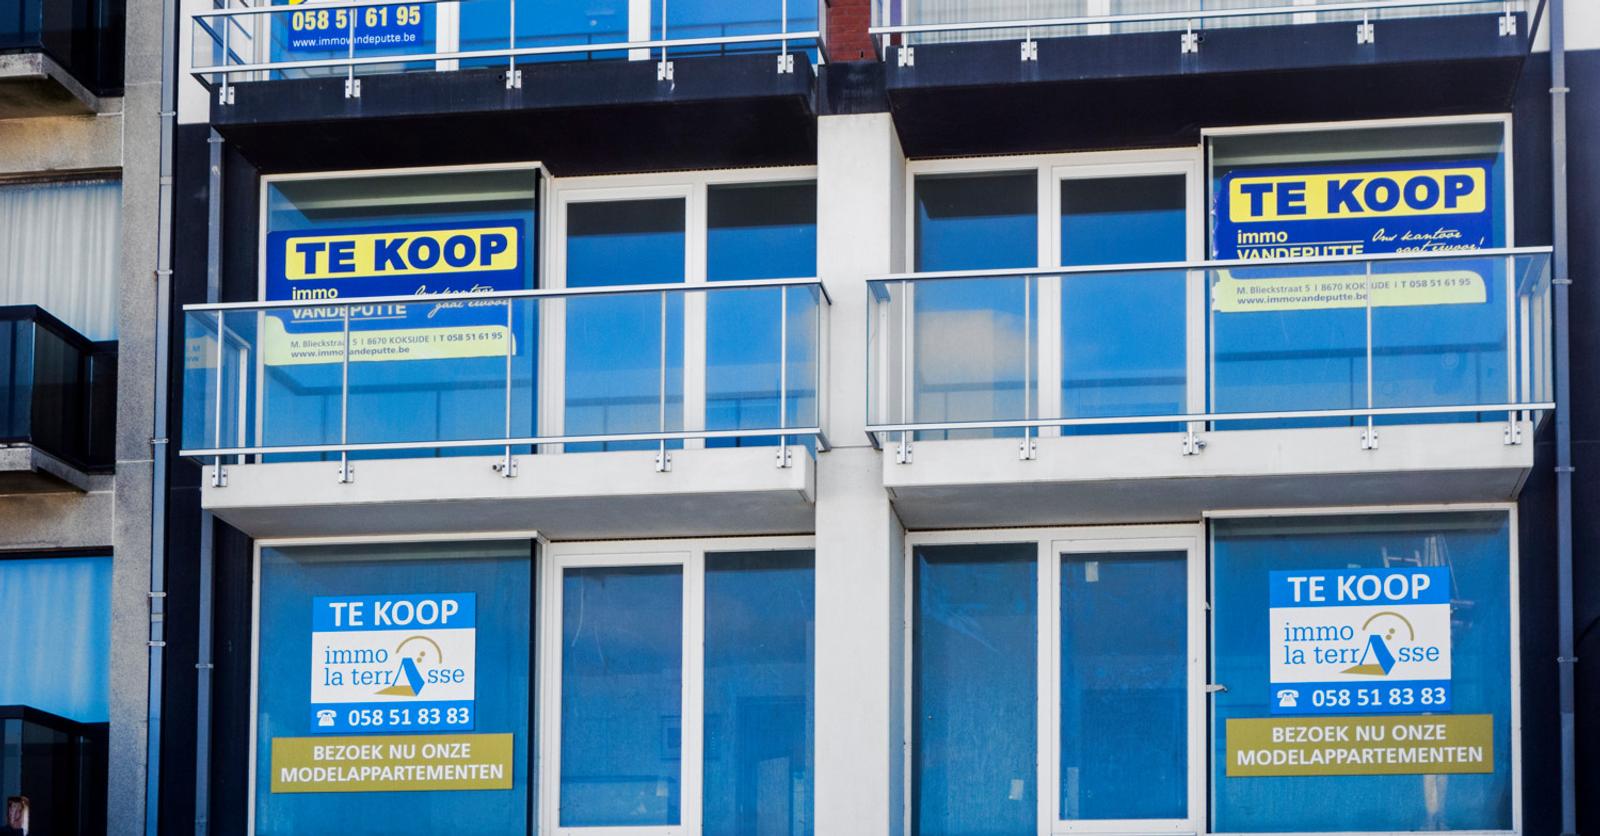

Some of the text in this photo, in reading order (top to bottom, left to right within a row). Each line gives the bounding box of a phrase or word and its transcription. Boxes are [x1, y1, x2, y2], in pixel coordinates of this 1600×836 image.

[292, 10, 329, 31] 058
[365, 7, 387, 27] 61
[396, 5, 421, 26] 95
[1240, 174, 1475, 217] TE KOOP
[1237, 230, 1288, 244] immo
[295, 233, 508, 275] TE KOOP
[292, 286, 338, 300] immo
[1321, 283, 1343, 292] 8670
[1409, 280, 1427, 288] 058
[1431, 279, 1442, 287] 51
[1444, 278, 1455, 286] 61
[1458, 277, 1471, 286] 95
[367, 336, 388, 345] 8670
[447, 333, 463, 342] 058
[466, 333, 476, 341] 51
[479, 332, 489, 341] 61
[491, 331, 503, 340] 95
[290, 346, 410, 358] www.immoandeputte.be
[1287, 573, 1431, 603] TE KOOP
[328, 599, 459, 627] TE KOOP
[1284, 621, 1354, 642] immo
[324, 645, 388, 665] immo
[1284, 645, 1306, 665] la
[324, 667, 344, 686] la
[1312, 687, 1446, 707] 058 51 83 83
[348, 707, 470, 726] 058 51 83 83
[1272, 724, 1446, 743] BEZOEK NU ONZE
[313, 743, 471, 761] BEZOEK NU ONZE
[1237, 746, 1483, 766] MODELAPPARTEMENTEN
[280, 763, 503, 783] MODELAPPARTEMENTEN
